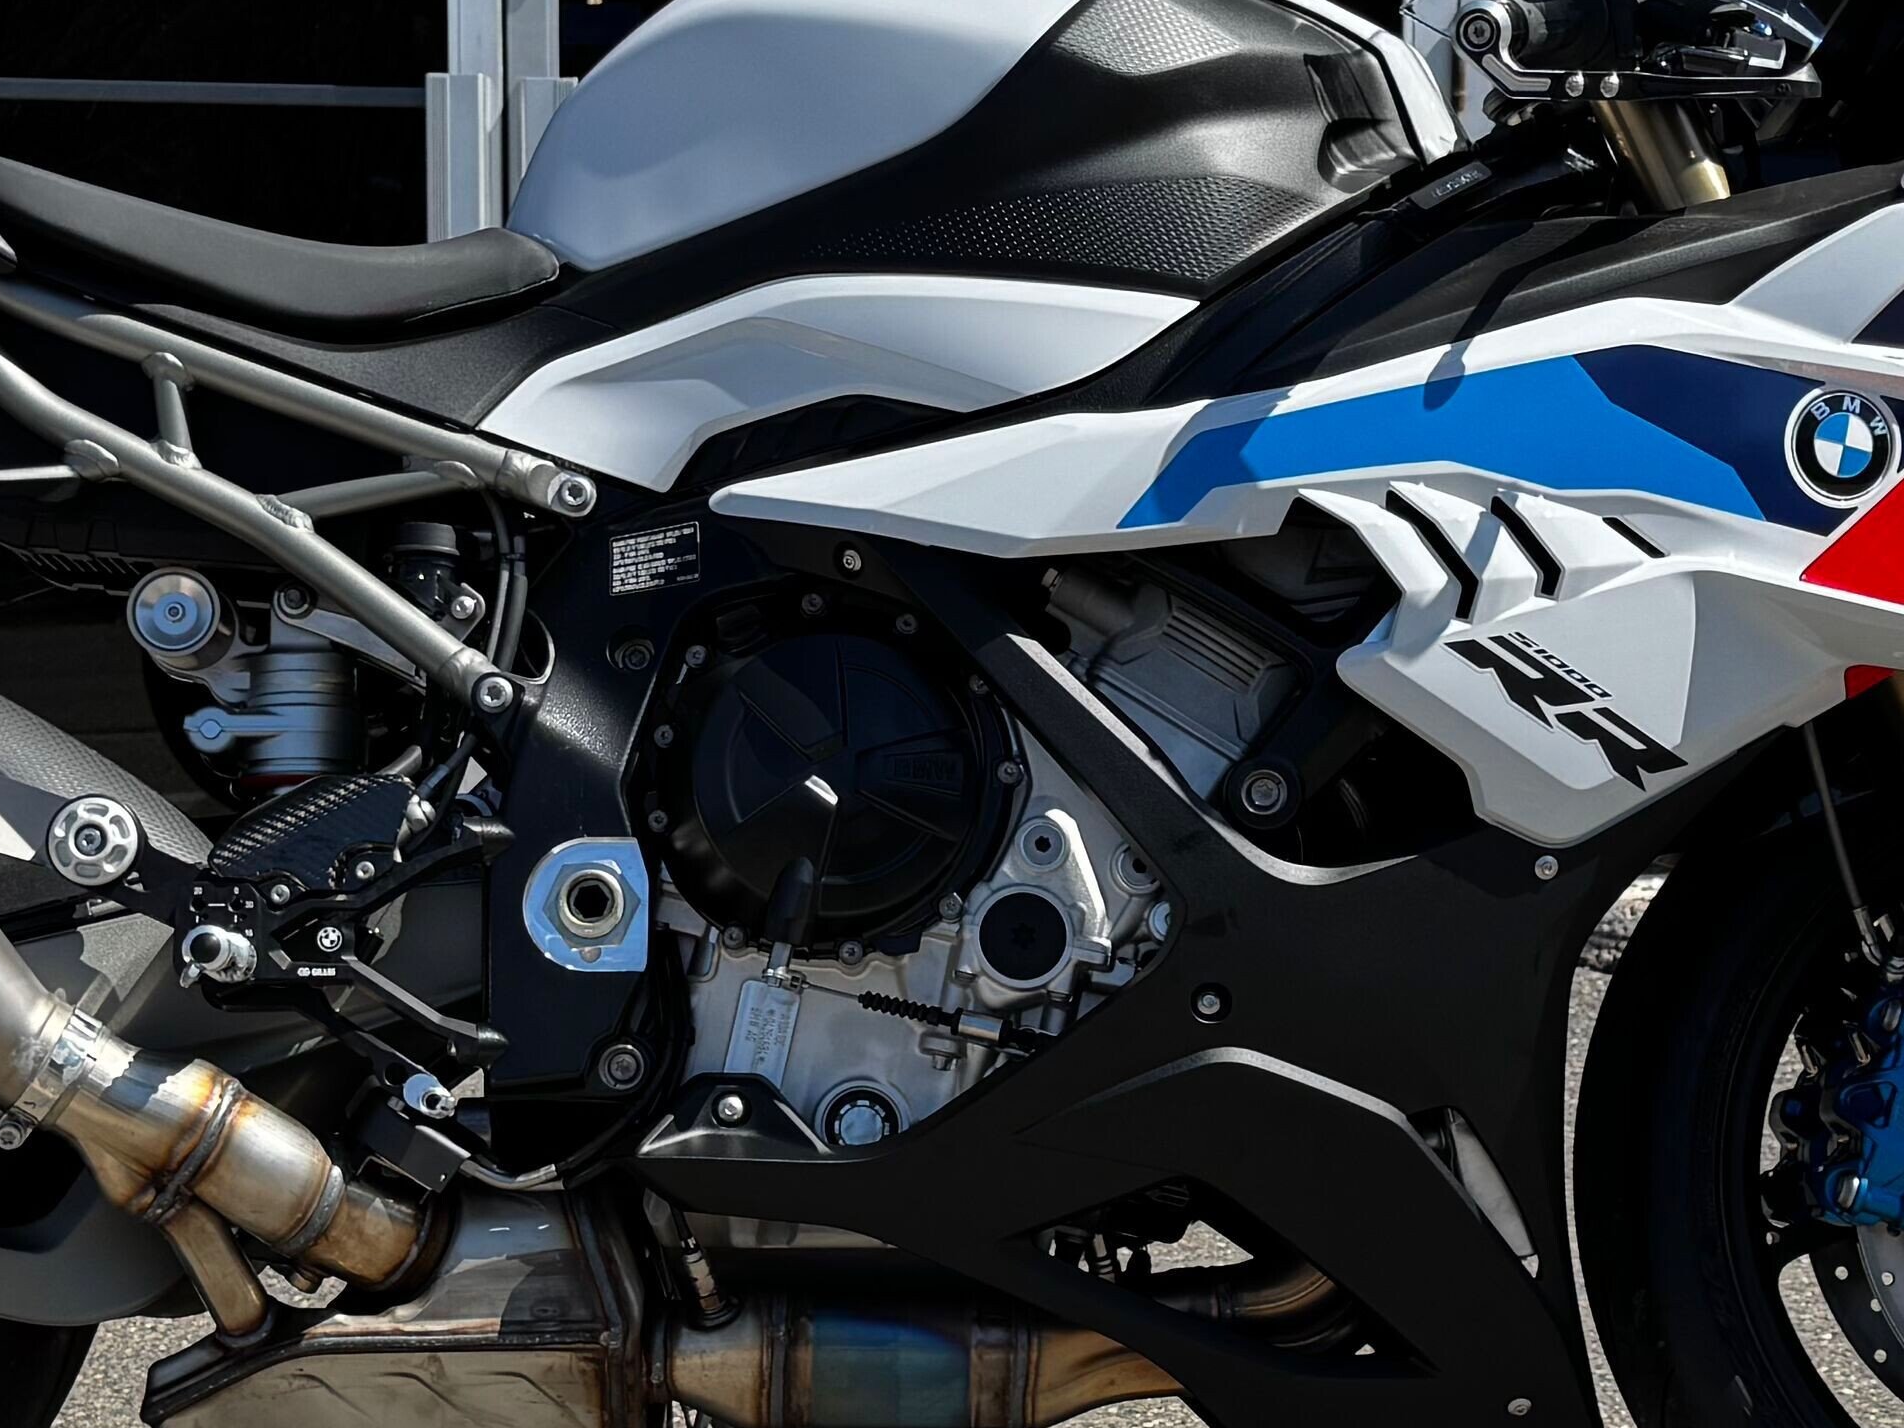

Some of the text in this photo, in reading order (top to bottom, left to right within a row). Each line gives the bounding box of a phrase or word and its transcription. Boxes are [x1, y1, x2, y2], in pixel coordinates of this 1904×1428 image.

[1810, 395, 1888, 436] BMW
[1508, 631, 1613, 699] S1000
[1442, 635, 1689, 792] RR
